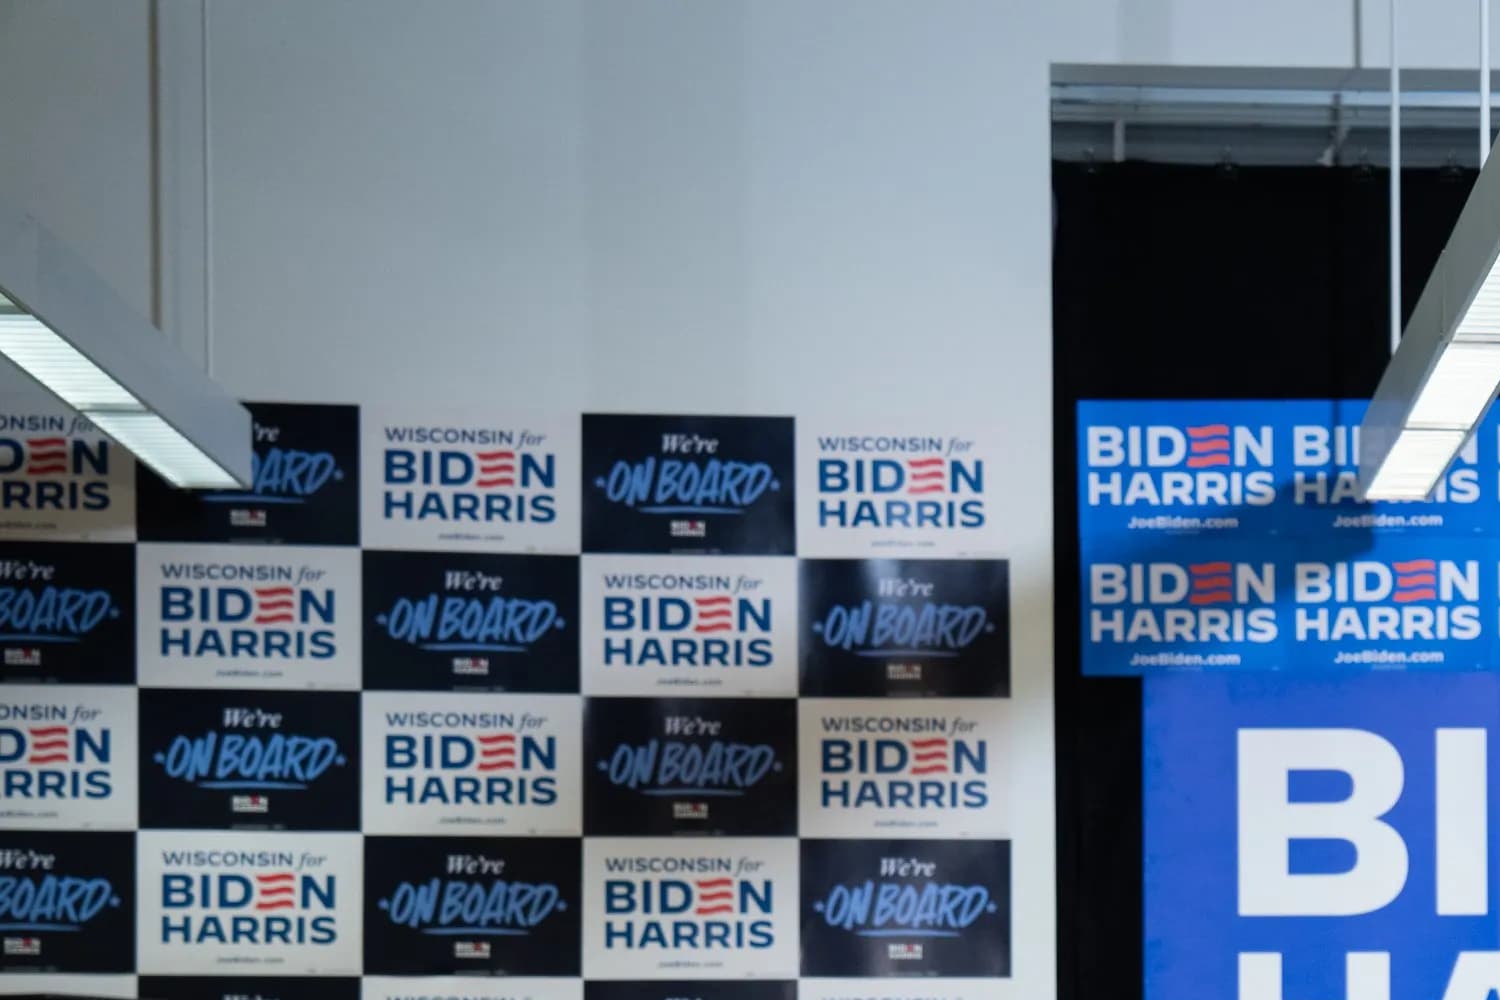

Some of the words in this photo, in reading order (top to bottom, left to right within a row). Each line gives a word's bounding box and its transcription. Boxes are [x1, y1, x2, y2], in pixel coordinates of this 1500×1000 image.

[384, 427, 513, 444] WISCONSIN
[515, 430, 546, 450] for
[662, 434, 718, 453] We're
[1087, 425, 1273, 468] BIDEN
[384, 448, 554, 489] BIDEN
[1088, 473, 1276, 505] HARRIS
[384, 491, 555, 523] HARRIS
[1333, 515, 1442, 528] JoeBiden.com
[1128, 517, 1238, 529] JoeBiden.com
[160, 563, 291, 580] WISCONSIN
[294, 566, 326, 585] for
[604, 574, 730, 590] WISCONSIN
[733, 575, 762, 595] for
[1090, 562, 1275, 605] BIDEN
[1295, 559, 1478, 603] BIDEN
[160, 585, 334, 625] BIDEN
[604, 596, 771, 633] BIDEN
[1091, 609, 1278, 642] HARRIS
[1296, 605, 1481, 641] HARRIS
[160, 628, 336, 658] HARRIS
[604, 638, 773, 667] HARRIS
[1334, 650, 1444, 663] JoeBiden.com
[1130, 654, 1240, 666] JoeBiden.com
[224, 708, 282, 728] We're
[386, 712, 514, 728] WISCONSIN
[517, 713, 547, 733] for
[386, 734, 556, 771] BIDEN
[386, 777, 557, 806] HARRIS
[162, 851, 293, 867] WISCONSIN
[296, 852, 327, 872] for
[605, 857, 731, 872] WISCONSIN
[734, 857, 763, 879] for
[881, 858, 936, 877] We're
[162, 873, 335, 911] BIDEN
[605, 878, 772, 915] BIDEN
[162, 916, 336, 944] HARRIS
[605, 921, 774, 949] HARRIS
